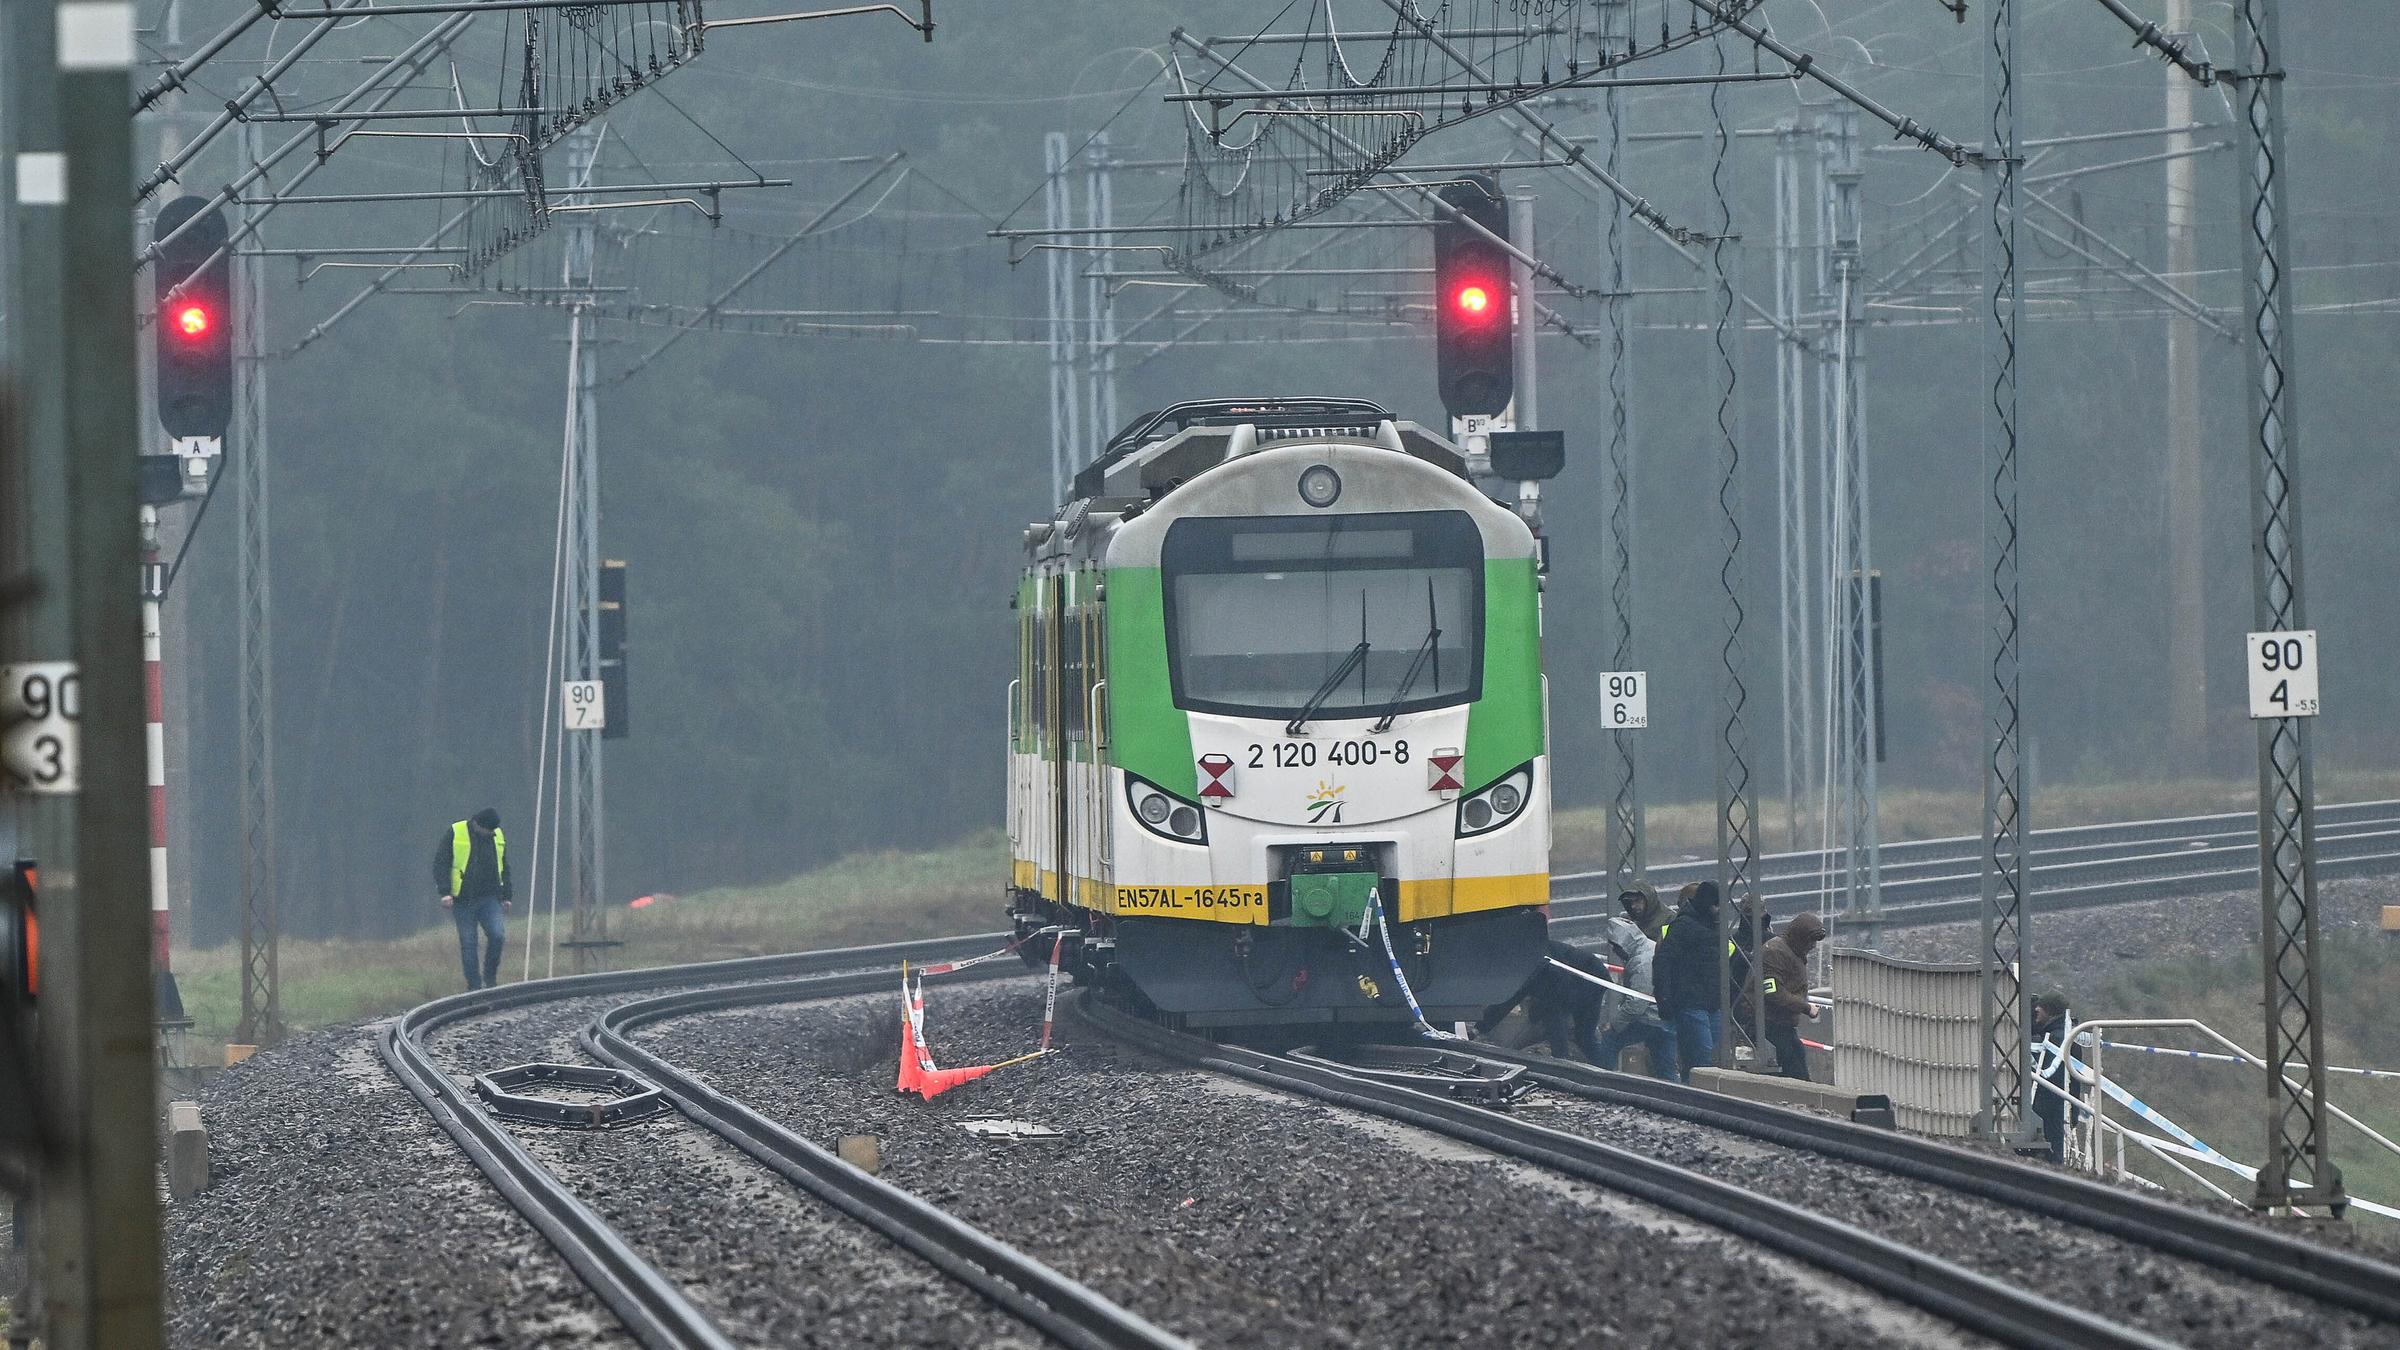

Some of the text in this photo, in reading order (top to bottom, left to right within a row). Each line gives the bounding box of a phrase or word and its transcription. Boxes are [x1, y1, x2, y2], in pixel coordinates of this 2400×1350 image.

[193, 440, 200, 454] A
[2261, 638, 2303, 672] 90
[23, 672, 81, 721] 90
[571, 685, 596, 704] 90
[1609, 675, 1637, 698] 90
[2269, 678, 2289, 712] 4
[575, 707, 587, 726] 7
[1613, 702, 1627, 725] 6
[34, 735, 63, 784] 3
[1247, 740, 1410, 769] 2 120 400-8
[1117, 888, 1264, 909] EN57AL-1645ra
